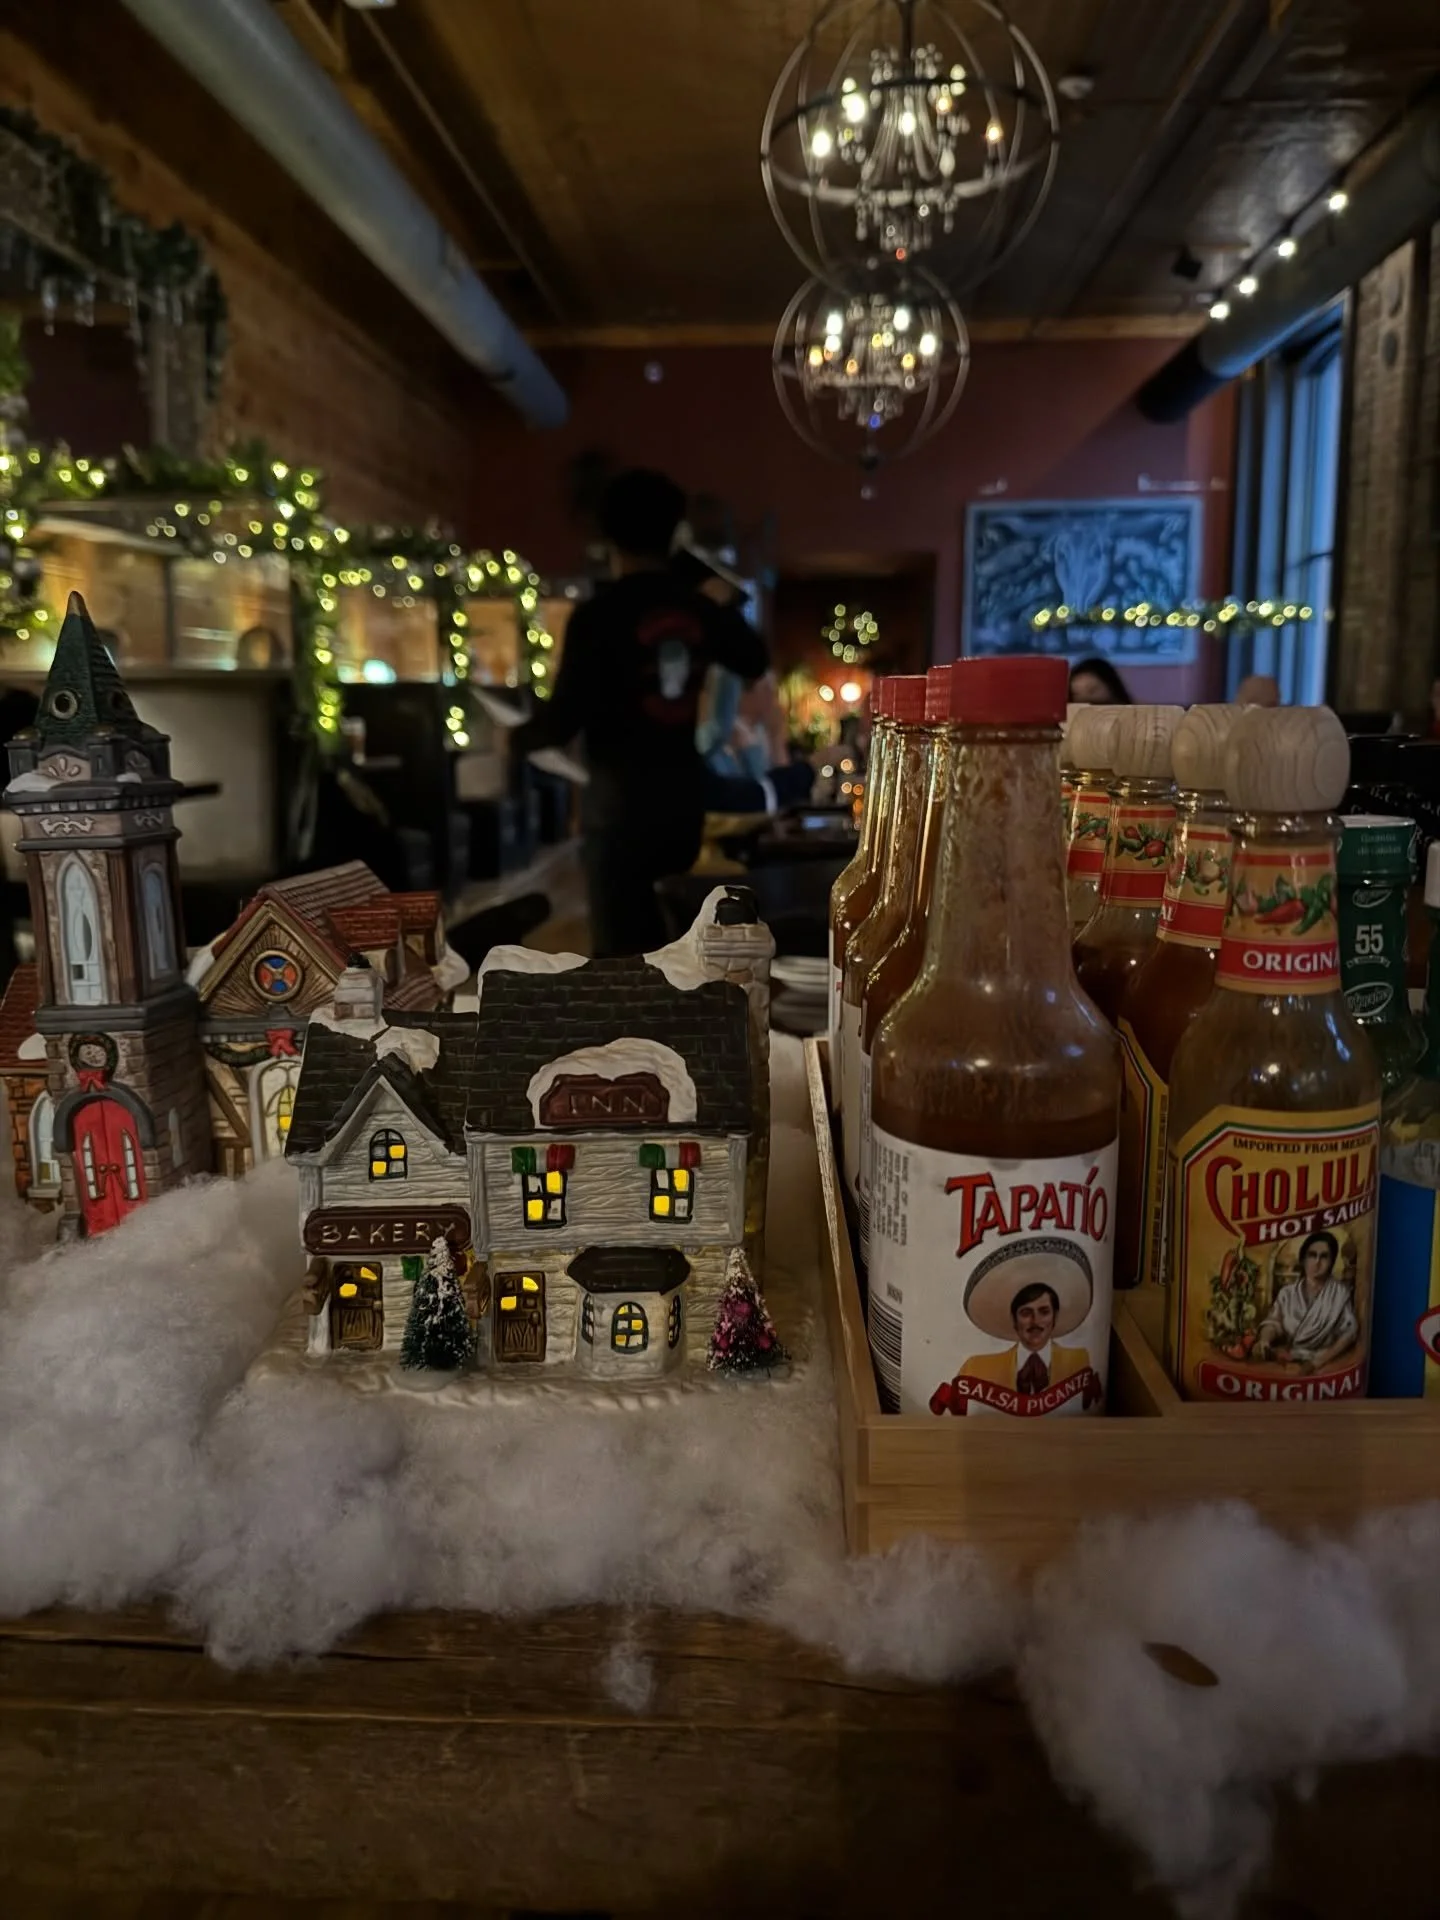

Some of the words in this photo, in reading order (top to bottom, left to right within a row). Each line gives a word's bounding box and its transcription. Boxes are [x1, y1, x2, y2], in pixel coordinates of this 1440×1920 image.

[1354, 923, 1385, 955] 55
[569, 1092, 648, 1115] INN
[1233, 1137, 1301, 1154] IMPORTED
[1304, 1139, 1338, 1154] FROM
[944, 1166, 1108, 1258] TAPATÍO
[320, 1221, 457, 1245] BAKERY
[1259, 1216, 1316, 1241] HOT
[957, 1379, 1019, 1413] SALSA
[1026, 1370, 1091, 1414] PICANTE
